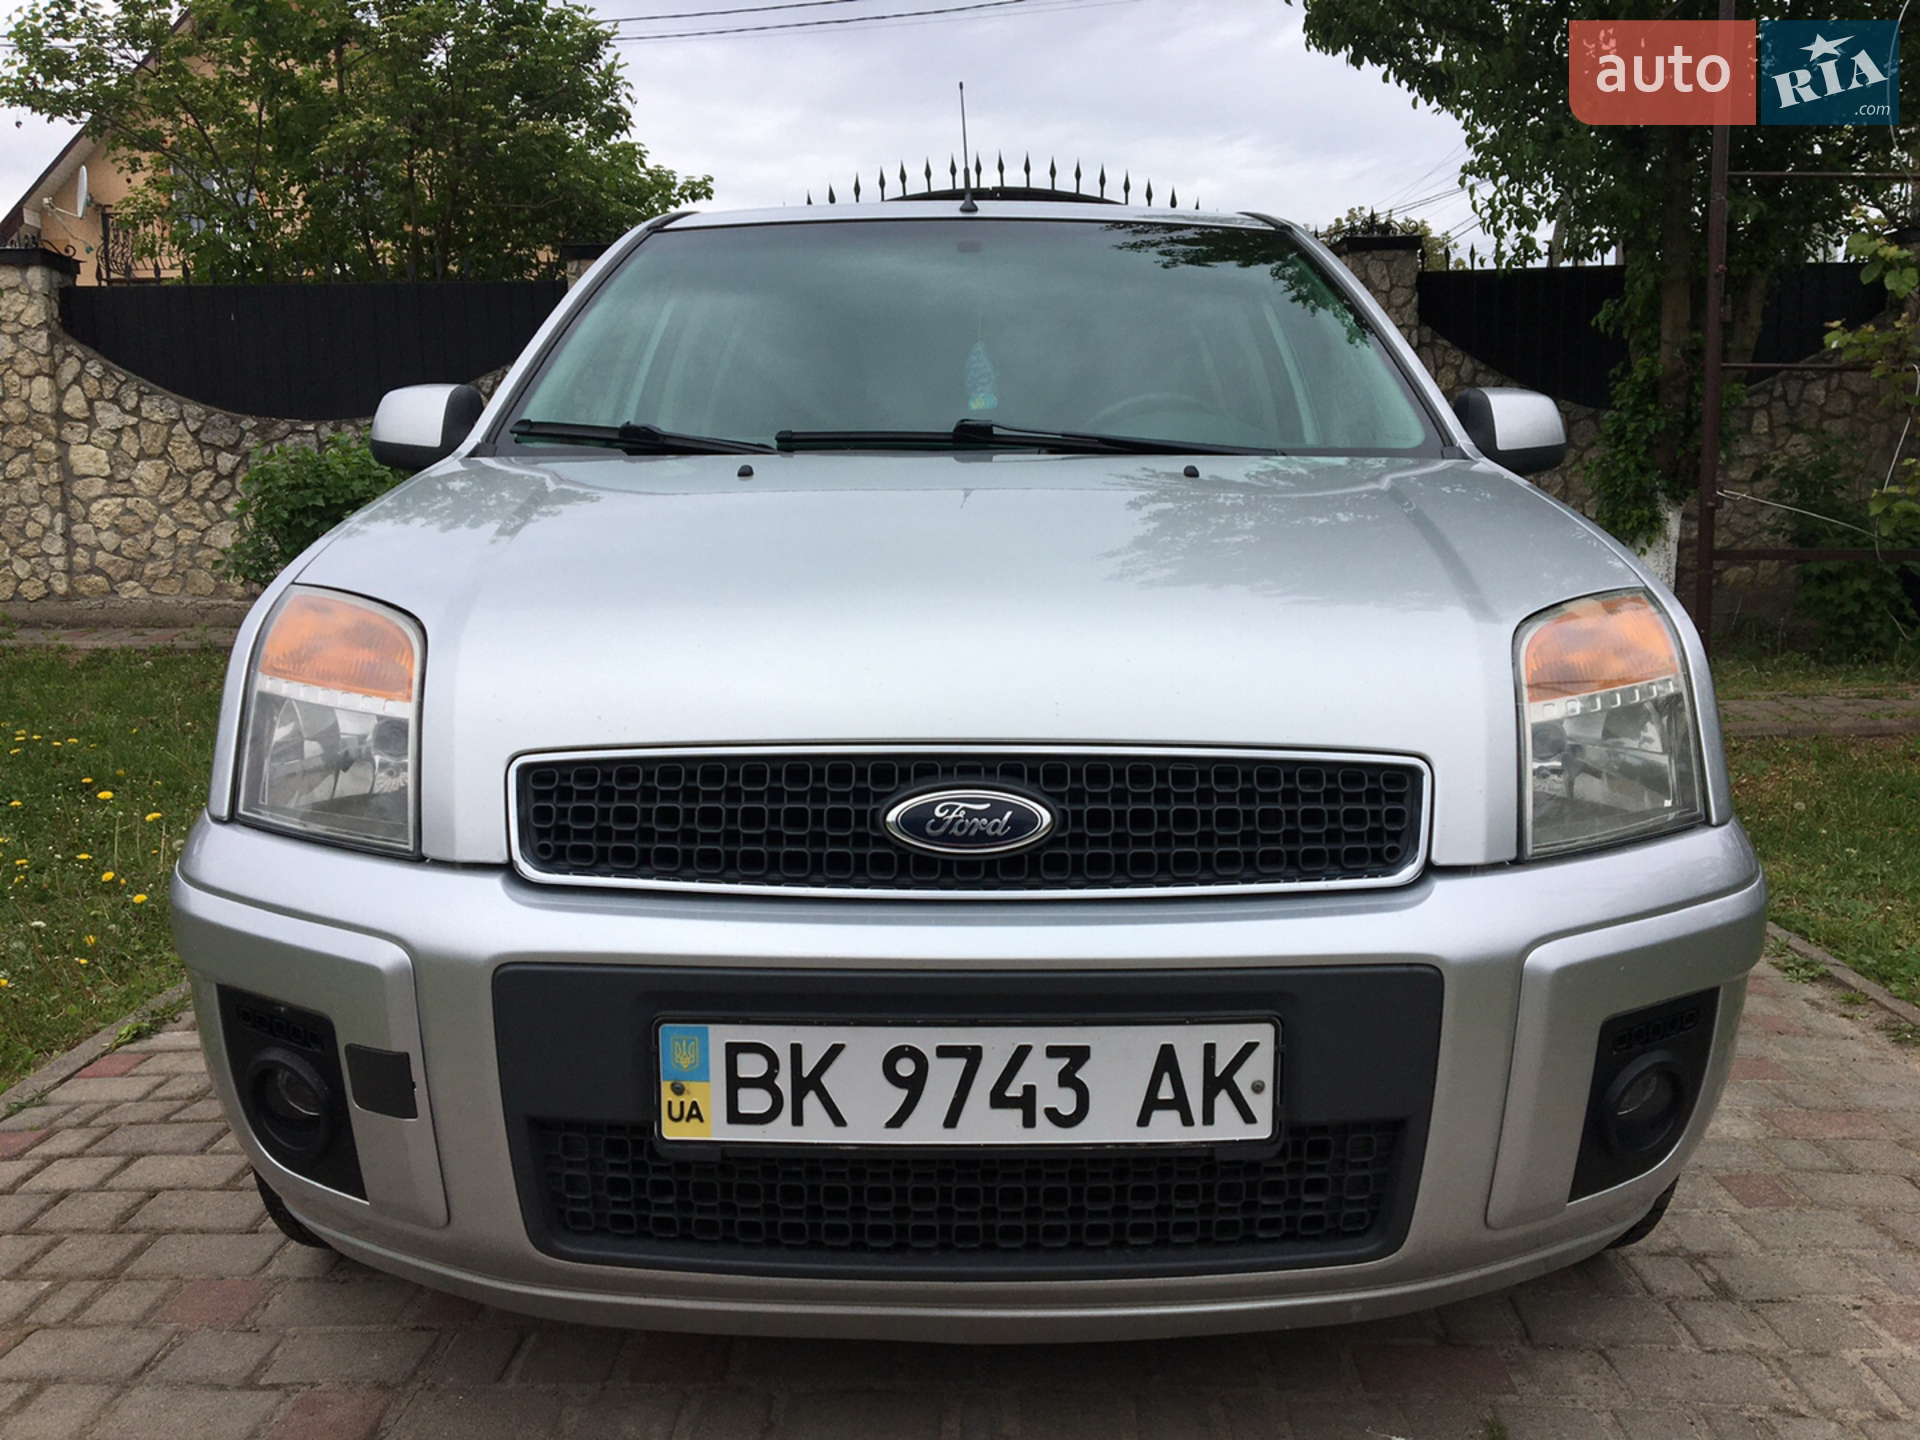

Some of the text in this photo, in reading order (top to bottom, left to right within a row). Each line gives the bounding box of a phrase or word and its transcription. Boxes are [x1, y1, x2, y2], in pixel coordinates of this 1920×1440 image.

[925, 801, 1013, 837] Ford
[724, 1040, 1261, 1130] BK 9743 AK
[666, 1099, 705, 1123] UA
